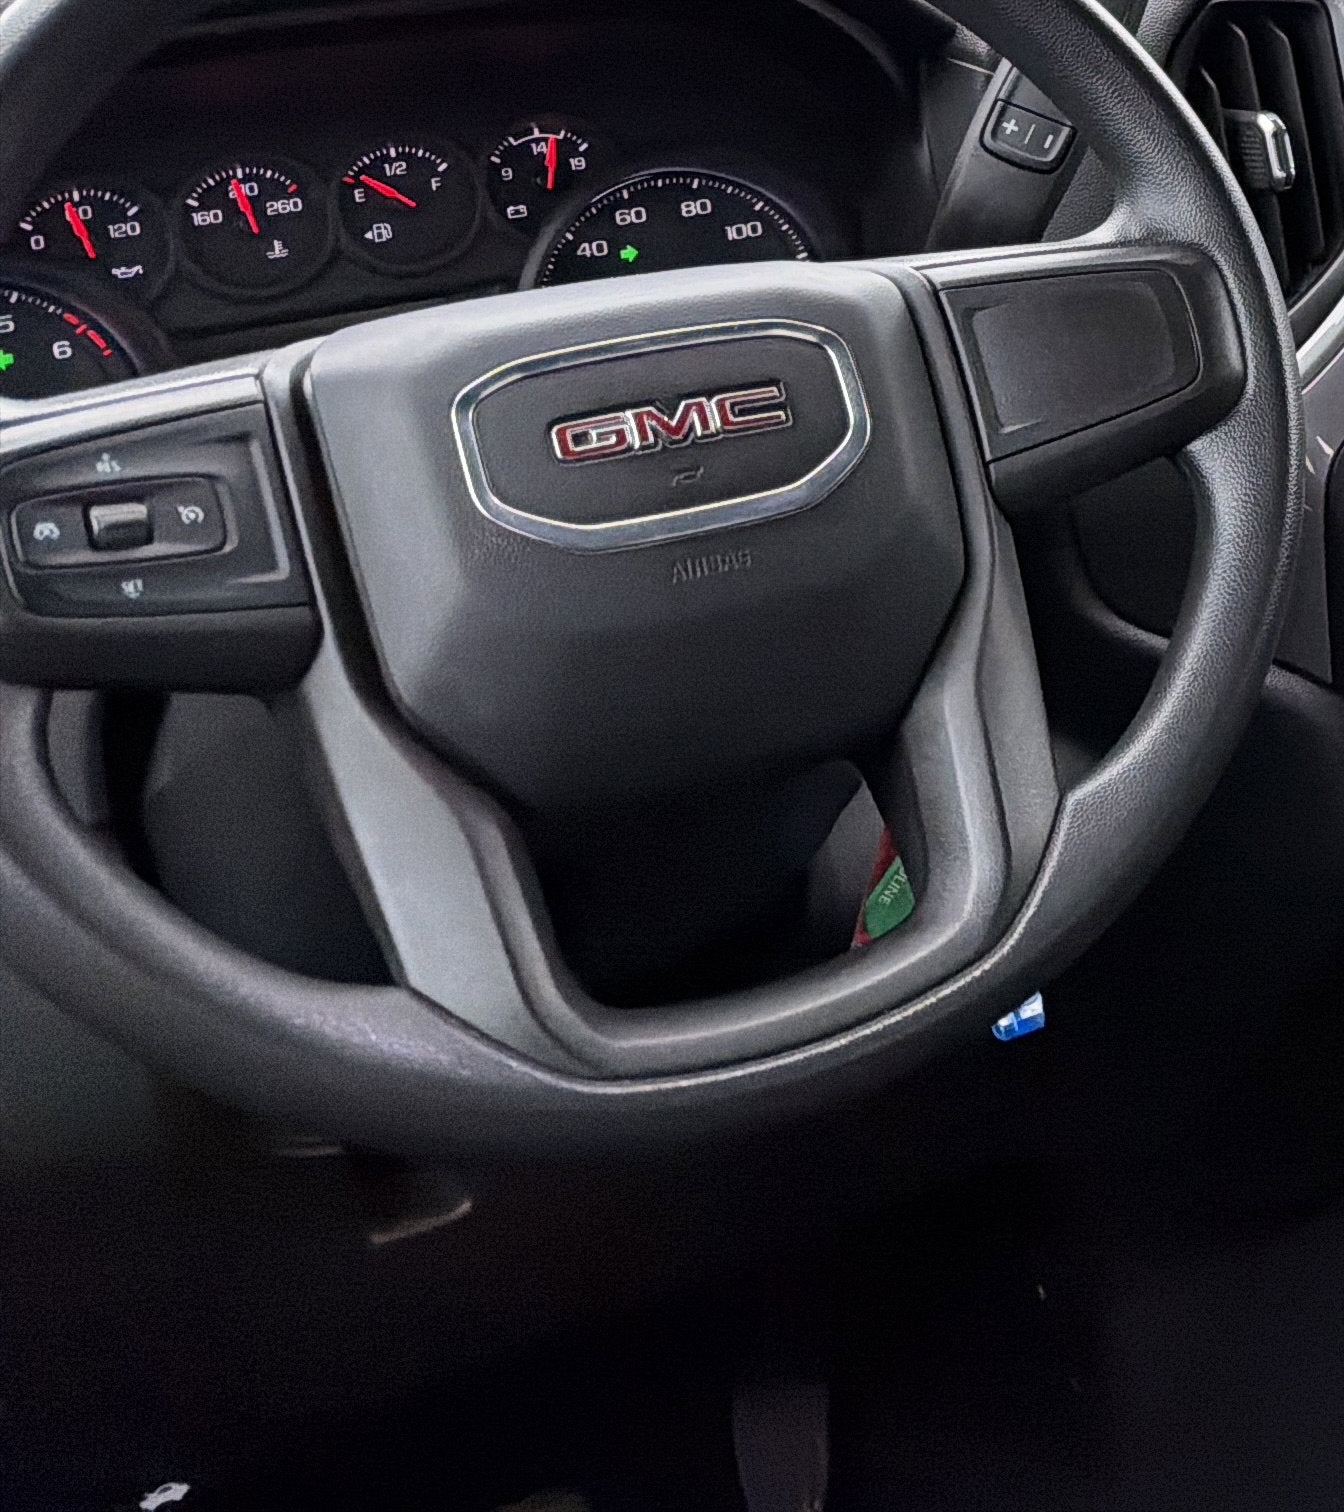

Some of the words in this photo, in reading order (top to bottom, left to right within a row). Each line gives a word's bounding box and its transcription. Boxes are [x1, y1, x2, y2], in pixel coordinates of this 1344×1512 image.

[530, 141, 549, 156] 14
[383, 161, 408, 177] 1/2
[568, 156, 586, 171] 19
[501, 167, 513, 181] 9
[430, 177, 443, 192] F
[353, 188, 366, 204] E
[265, 197, 303, 216] 260
[680, 198, 713, 218] 80
[190, 209, 223, 227] 160
[614, 206, 647, 226] 60
[107, 221, 141, 239] 120
[724, 221, 763, 241] 100
[29, 235, 45, 251] 0
[576, 240, 609, 258] 40
[51, 340, 73, 361] 6
[551, 383, 793, 466] GMC
